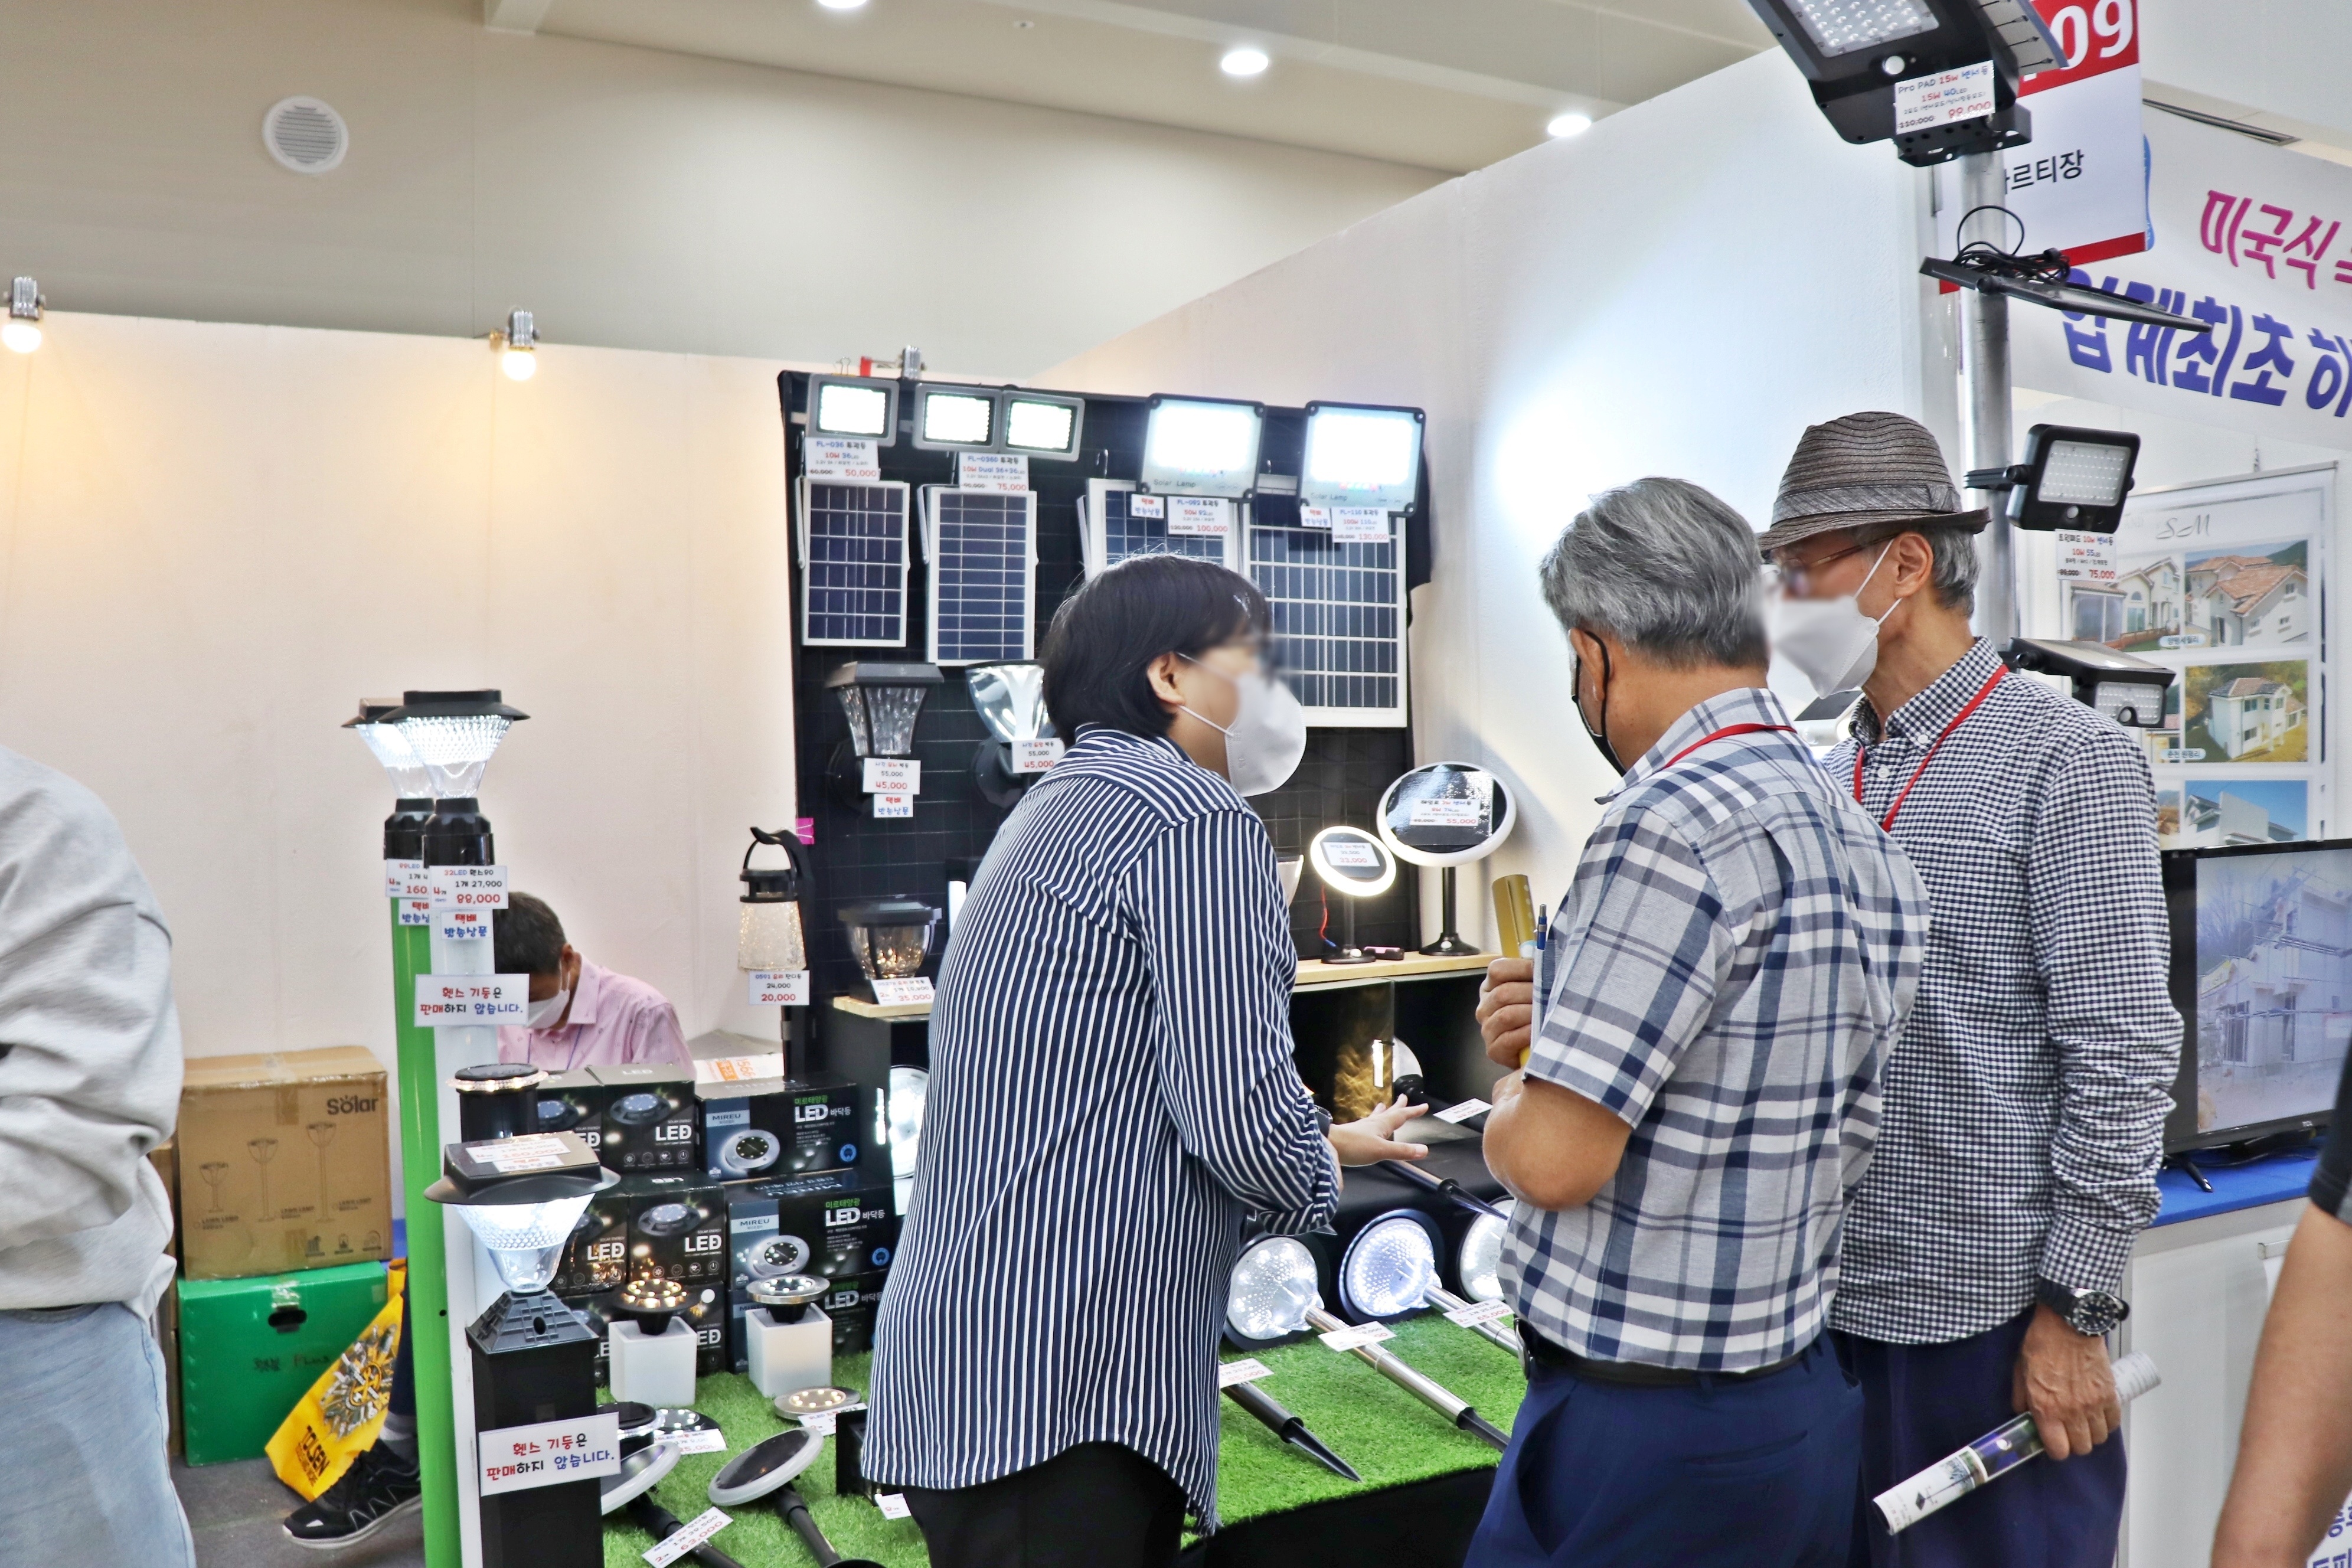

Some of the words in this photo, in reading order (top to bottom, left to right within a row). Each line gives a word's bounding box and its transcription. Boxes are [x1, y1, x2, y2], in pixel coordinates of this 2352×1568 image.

[1898, 85, 1915, 94] Pro
[1918, 79, 1936, 89] PAD
[1922, 92, 1941, 102] 15W
[2200, 189, 2341, 289] 미국식
[845, 469, 877, 477] 50,000
[998, 483, 1027, 491] 75,000
[2089, 569, 2115, 579] 75,000
[876, 781, 907, 789] 45,000
[457, 894, 500, 904] 88,000
[455, 914, 477, 924] 택배
[470, 987, 502, 999] 기둥은
[761, 994, 796, 1002] 20,000
[420, 1004, 466, 1015] 판매하지
[474, 1003, 523, 1014] 않습니다.
[327, 1095, 378, 1115] Solar
[795, 1104, 829, 1123] LED
[830, 1106, 851, 1117] 바닥등
[655, 1125, 692, 1141] LED
[740, 1218, 770, 1226] MIREU
[825, 1207, 861, 1227] LED
[863, 1209, 886, 1219] 바닥등
[685, 1234, 722, 1252] LED
[587, 1242, 625, 1260] LED
[825, 1290, 860, 1309] LED
[1477, 1309, 1509, 1321] 65,000
[547, 1433, 587, 1450] 기둥은
[486, 1461, 544, 1481] 판매하지
[554, 1450, 615, 1470] 않습니다.
[681, 1521, 723, 1550] 63,000
